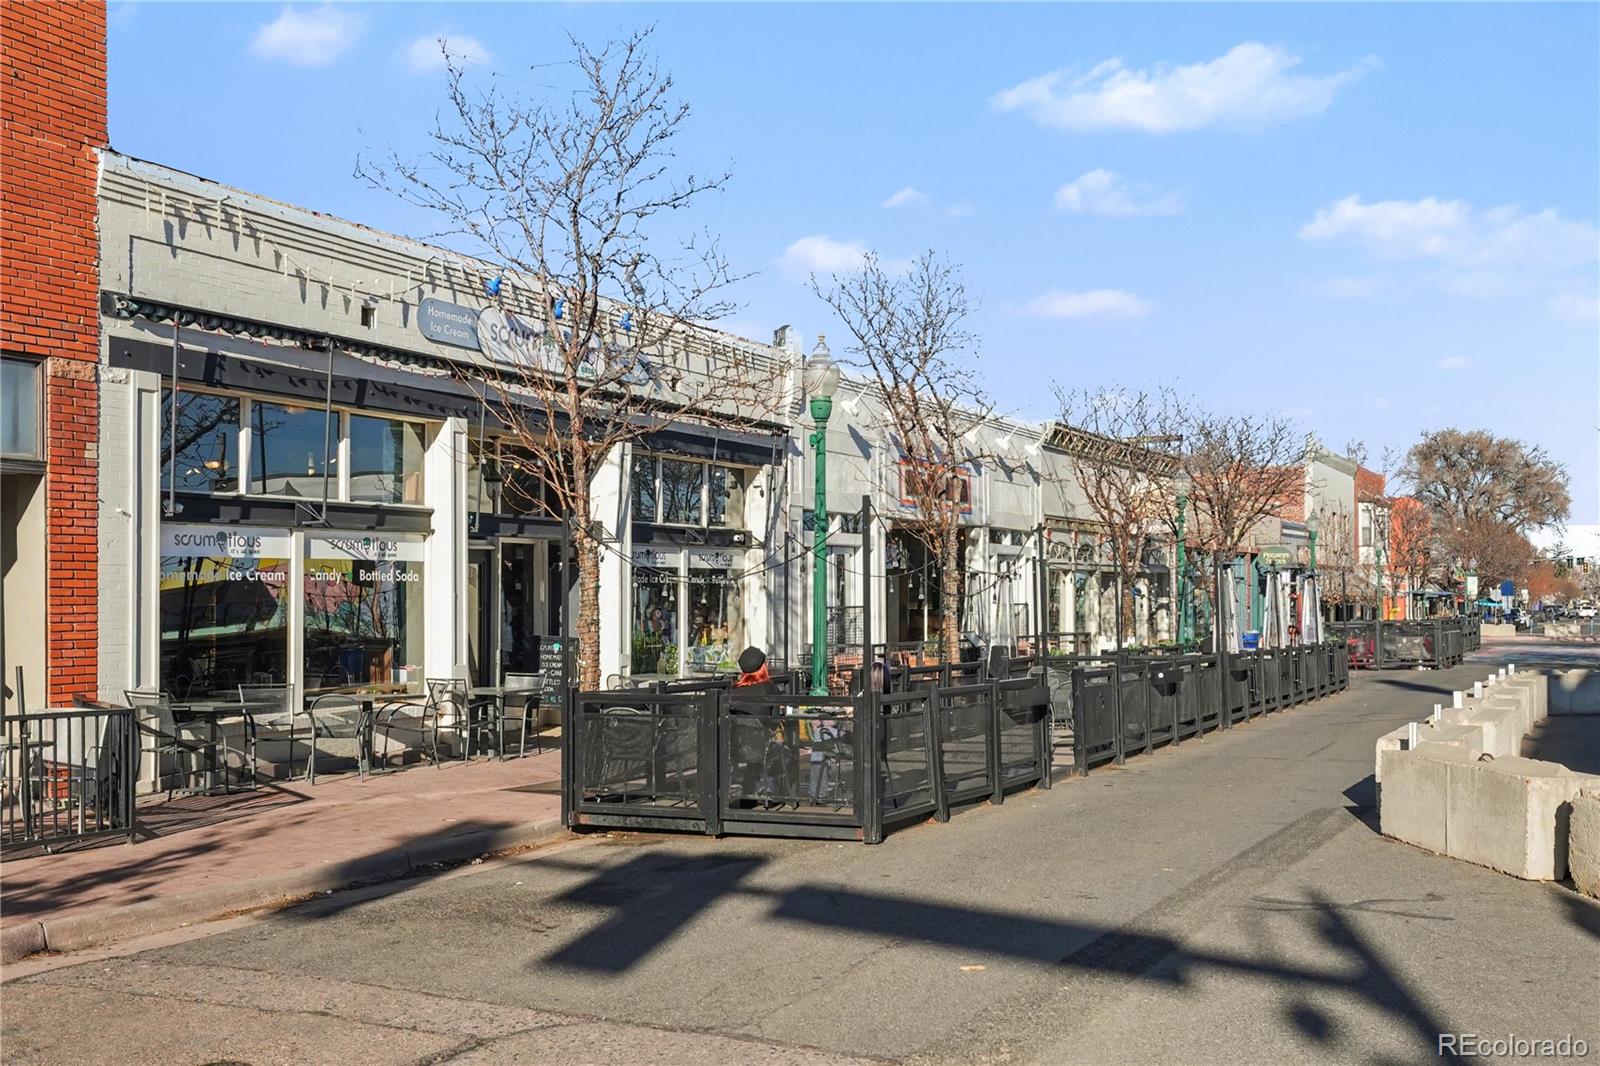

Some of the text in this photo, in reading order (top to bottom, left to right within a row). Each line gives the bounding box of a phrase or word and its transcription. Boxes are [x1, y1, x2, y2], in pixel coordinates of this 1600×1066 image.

[428, 306, 472, 324] Homemade
[430, 322, 470, 339] Ice Cream
[227, 568, 242, 581] Ice
[247, 567, 285, 581] Cream
[310, 568, 419, 584] Candy Bottled Soda
